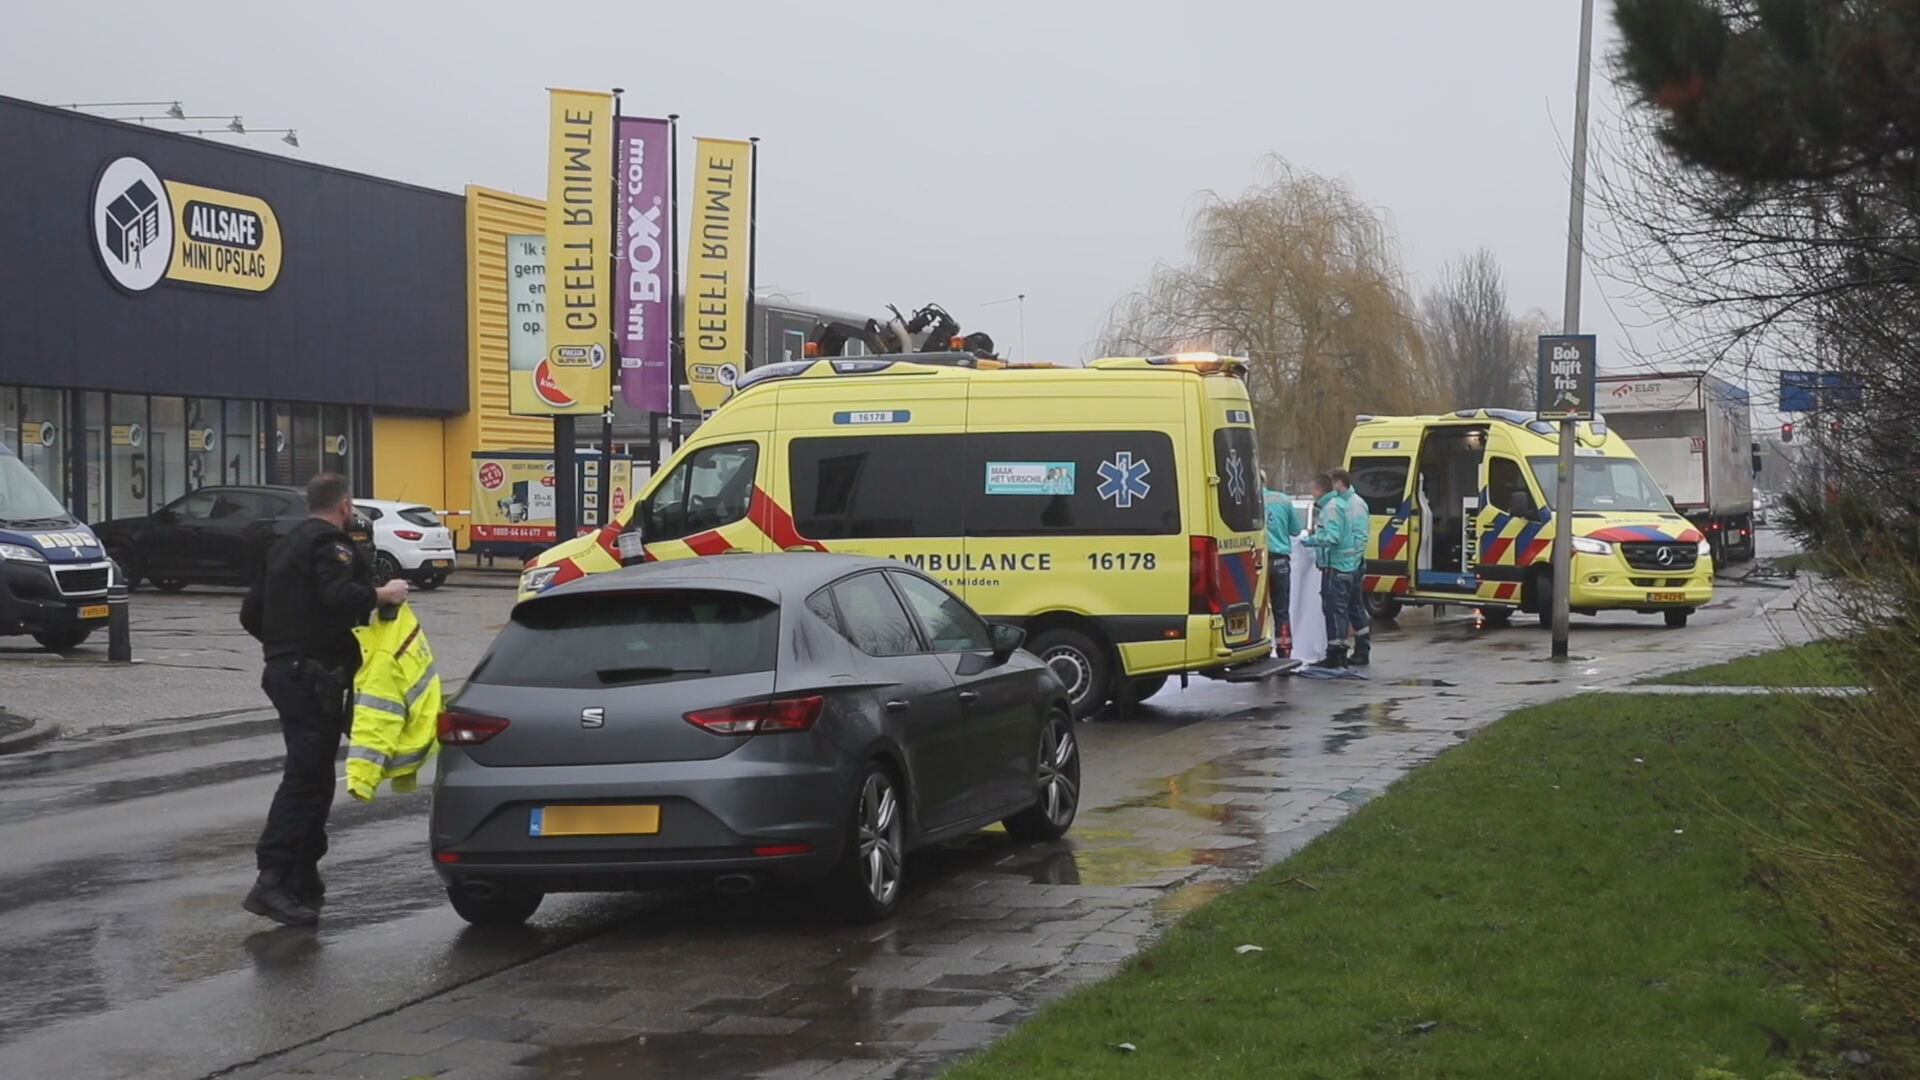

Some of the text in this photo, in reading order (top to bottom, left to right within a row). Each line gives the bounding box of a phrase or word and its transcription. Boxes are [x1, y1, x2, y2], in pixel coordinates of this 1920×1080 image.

[190, 205, 257, 246] ALLSAFE
[182, 241, 265, 278] MINI OPSLAG
[514, 264, 546, 278] gem
[1553, 346, 1580, 360] Bob
[1550, 361, 1582, 377] blijft
[1554, 375, 1577, 390] fris
[1634, 383, 1661, 393] ELST
[131, 452, 145, 500] 5
[889, 553, 1157, 571] MBULANCE 16178
[957, 577, 1000, 586] Midden
